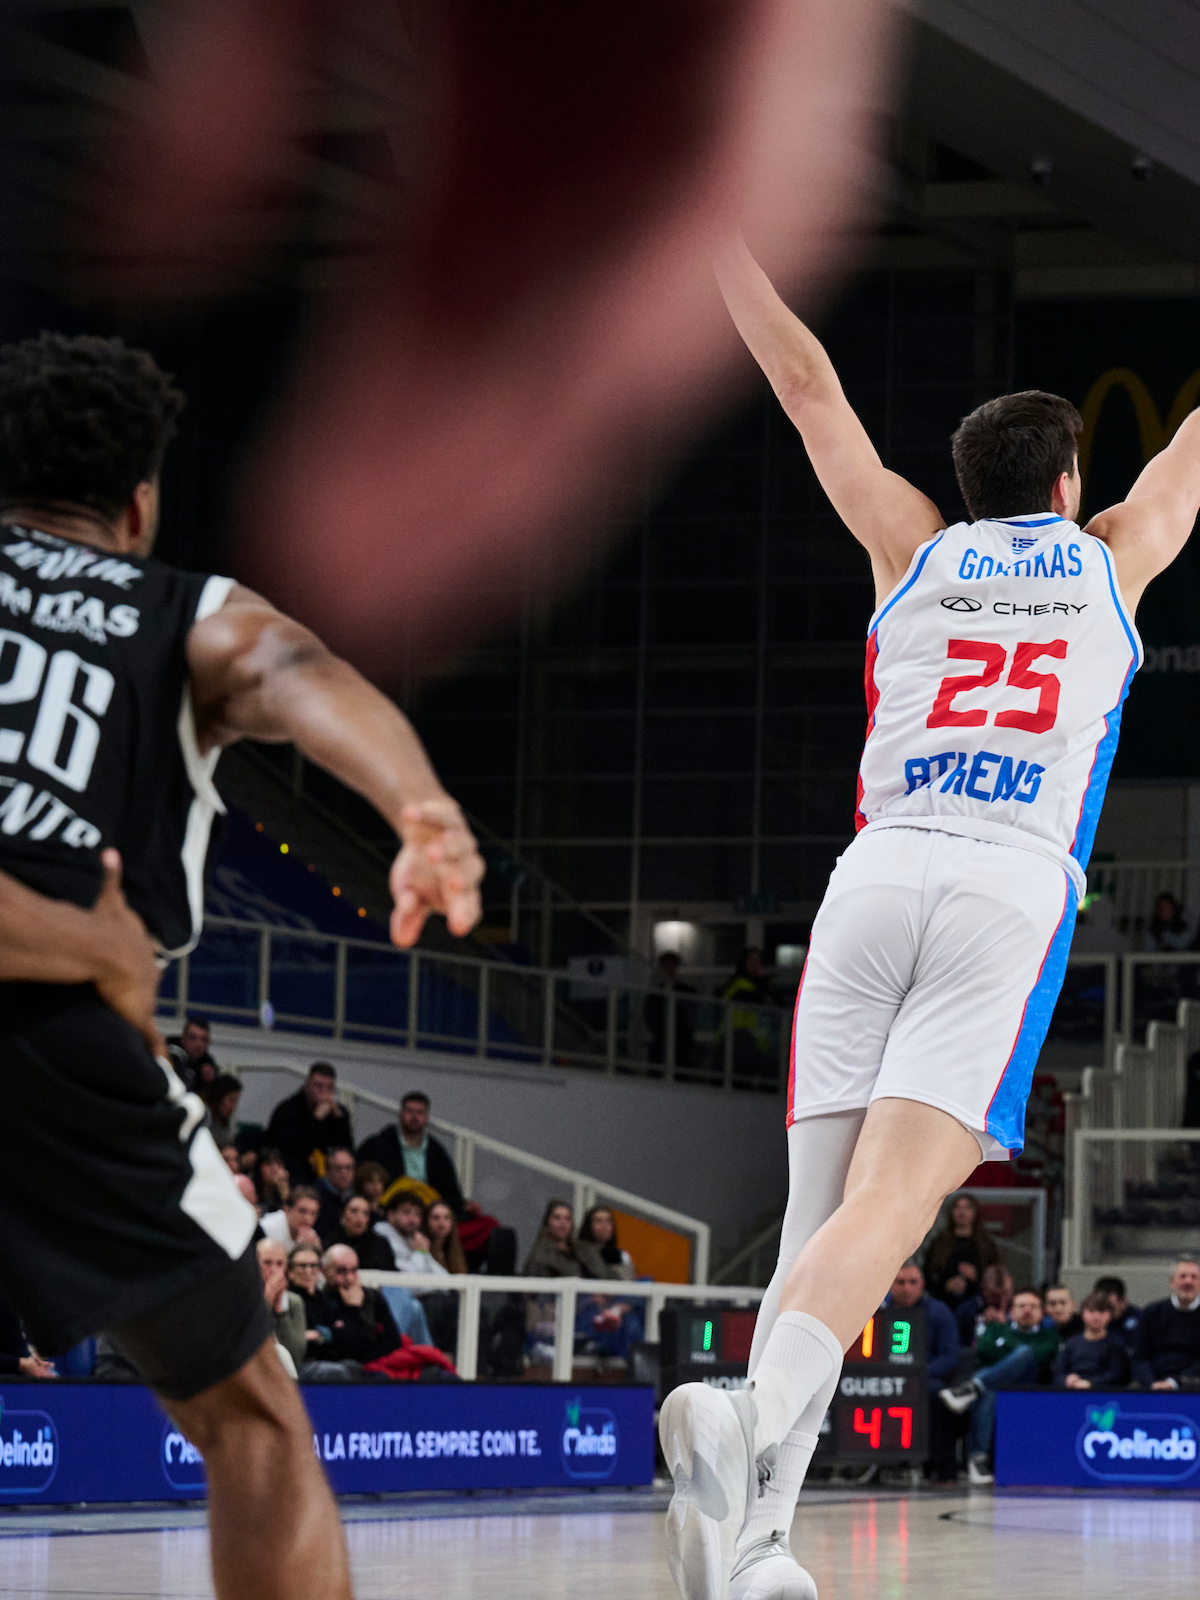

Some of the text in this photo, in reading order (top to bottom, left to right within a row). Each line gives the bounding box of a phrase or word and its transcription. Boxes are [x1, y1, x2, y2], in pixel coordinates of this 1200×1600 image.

[993, 602, 1089, 616] CHERY
[926, 638, 1068, 735] 25
[0, 627, 115, 793] 26
[904, 750, 1046, 804] ATHENS
[891, 1320, 911, 1354] 3
[703, 1376, 746, 1390] HOM
[841, 1376, 906, 1396] GUEST
[324, 1433, 346, 1460] LA
[349, 1432, 413, 1460] FRUTTA
[415, 1430, 480, 1457] SEMPRE
[482, 1430, 516, 1456] CON
[518, 1430, 542, 1456] TE.
[854, 1407, 912, 1450] 47
[1084, 1428, 1196, 1460] Melinda
